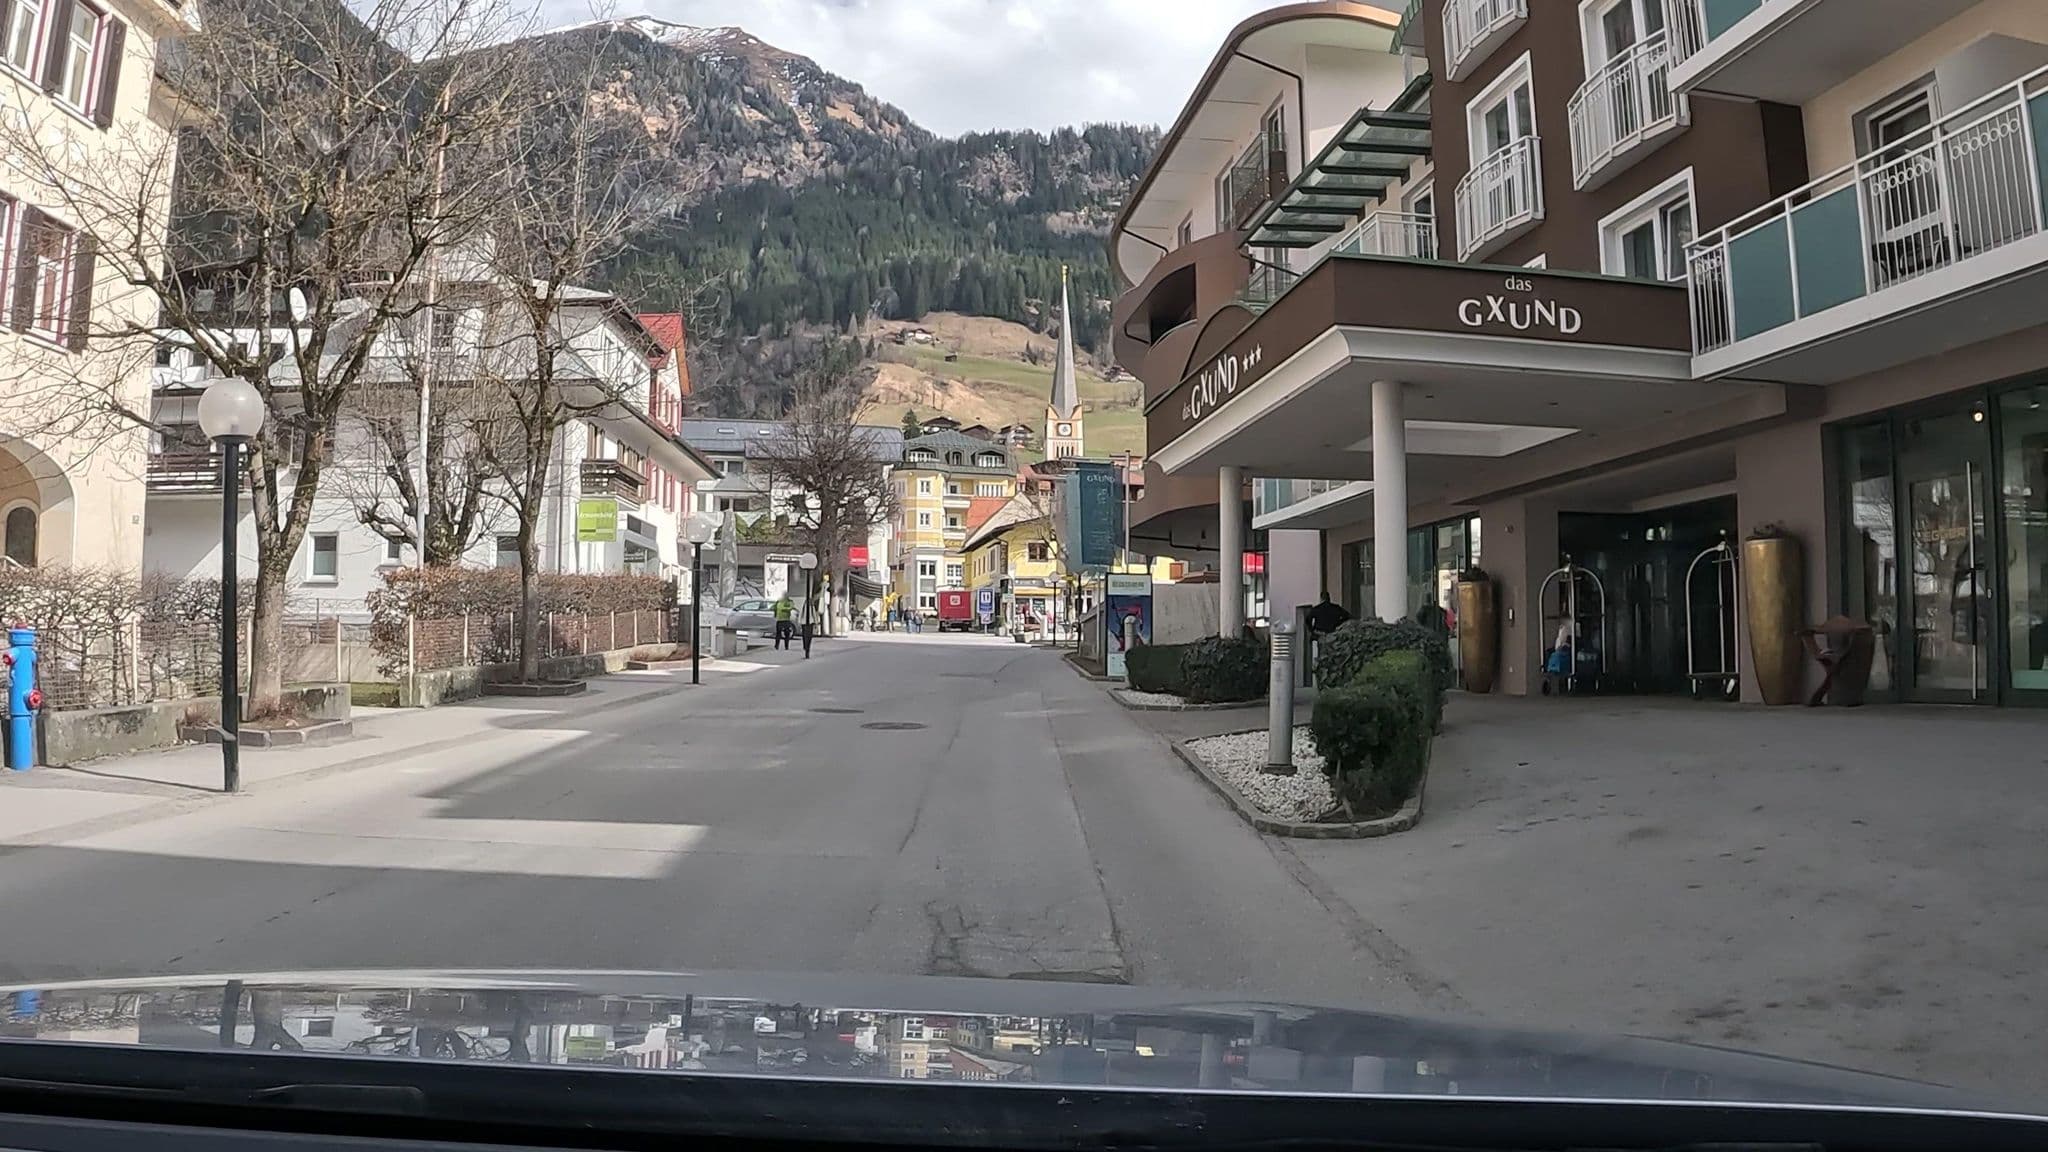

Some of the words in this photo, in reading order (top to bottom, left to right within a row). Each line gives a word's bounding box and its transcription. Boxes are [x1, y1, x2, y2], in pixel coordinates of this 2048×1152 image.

[1505, 275, 1533, 291] das
[1458, 295, 1582, 334] GXUND
[1191, 354, 1239, 419] GXUND
